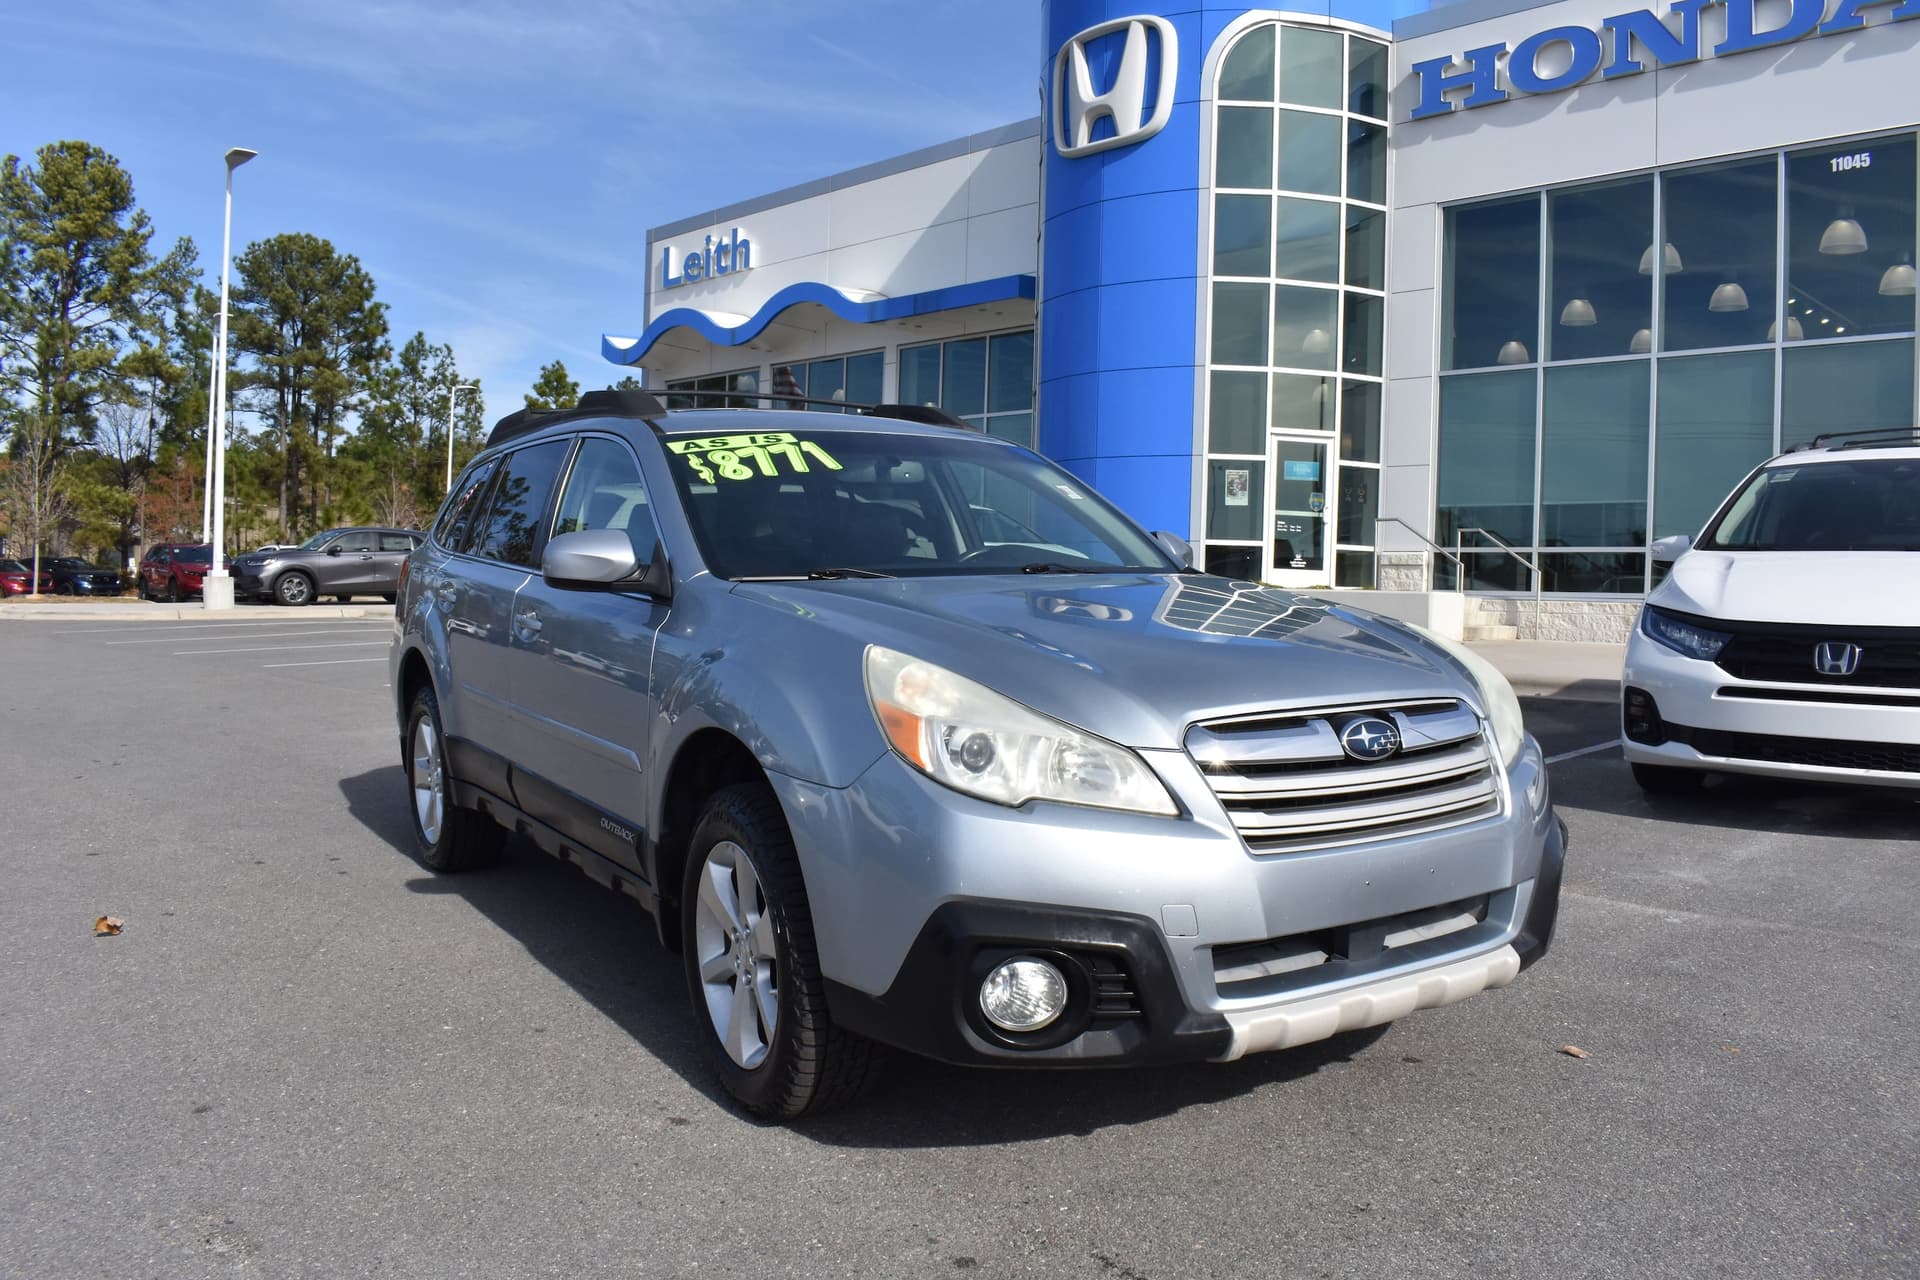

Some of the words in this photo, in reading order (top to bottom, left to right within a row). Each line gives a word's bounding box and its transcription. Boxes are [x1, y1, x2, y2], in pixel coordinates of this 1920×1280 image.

[1830, 152, 1871, 172] 11045
[663, 227, 750, 288] Leith
[683, 438, 729, 451] AS
[748, 434, 784, 445] IS
[686, 441, 843, 484] $8771
[600, 817, 635, 844] OUTBACK
